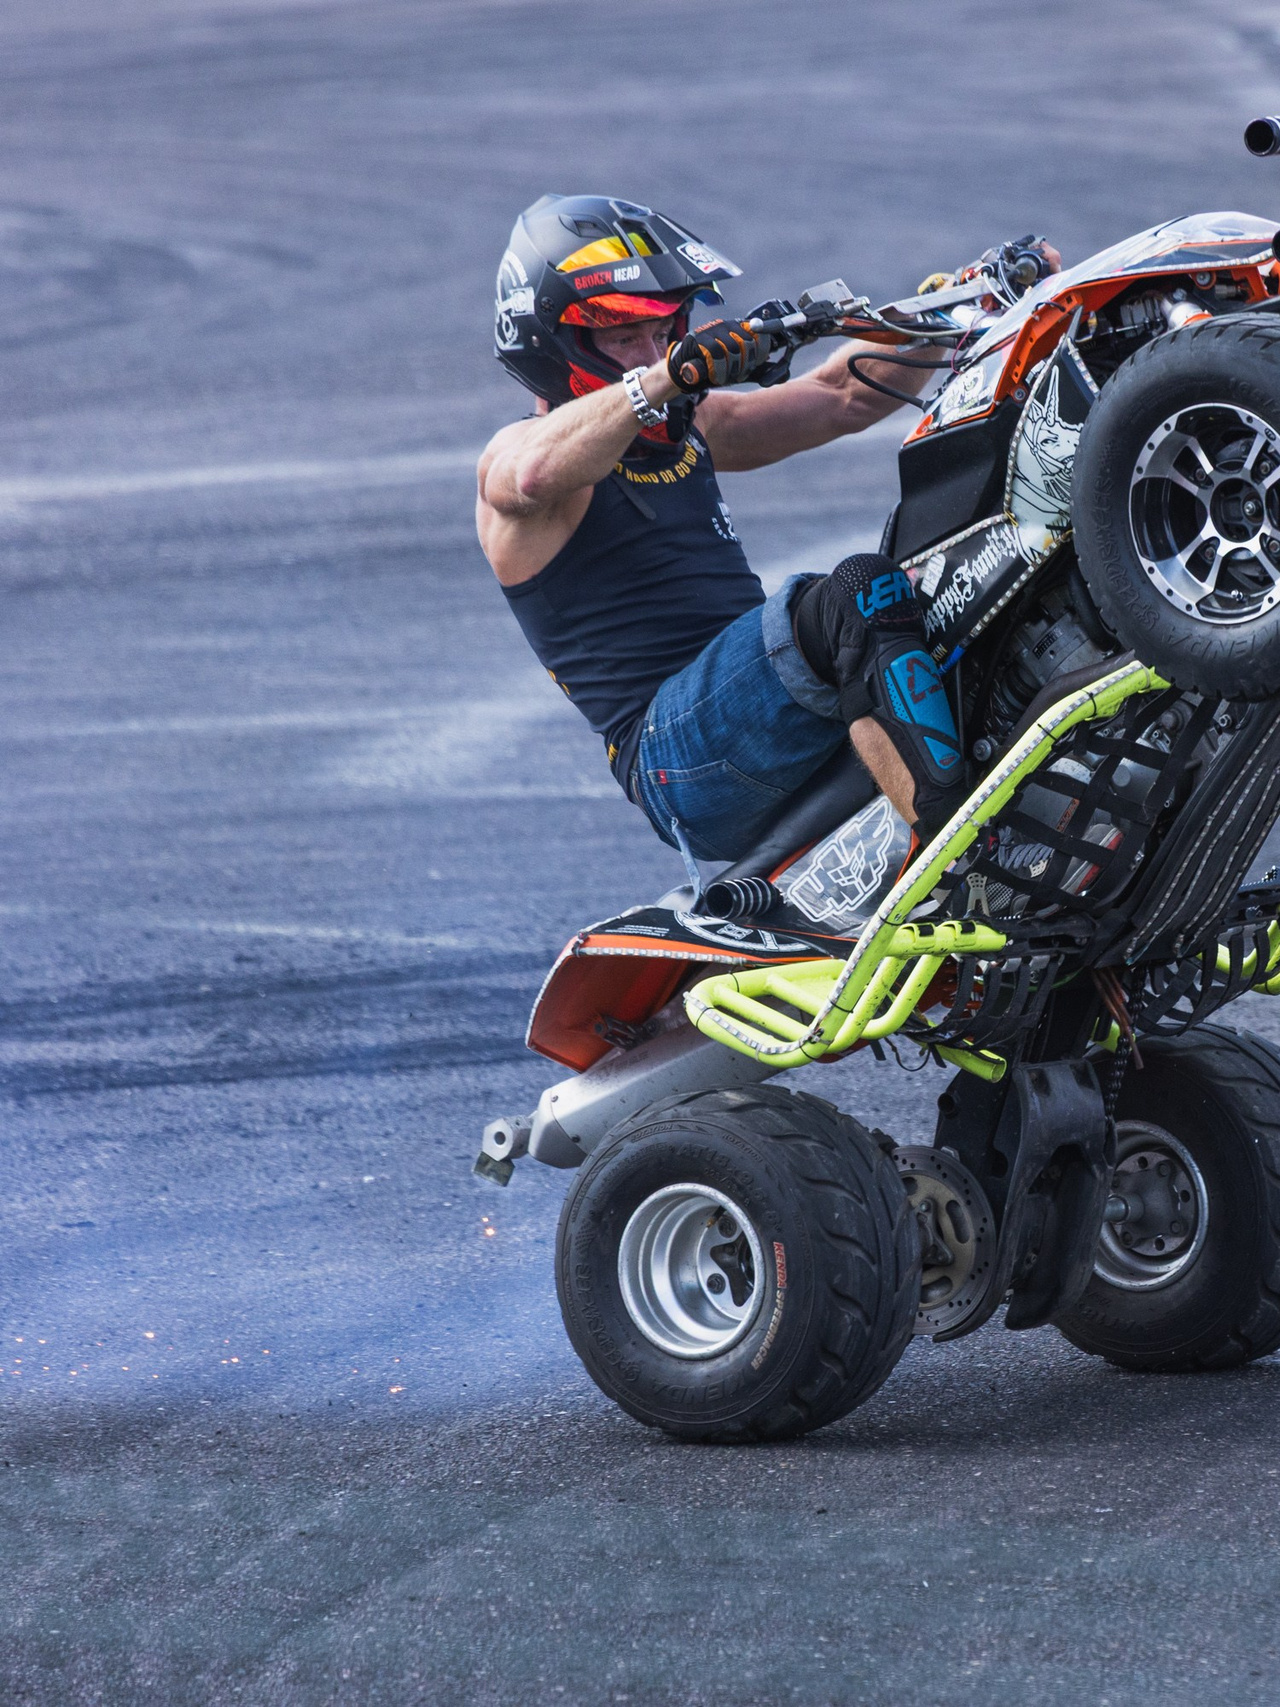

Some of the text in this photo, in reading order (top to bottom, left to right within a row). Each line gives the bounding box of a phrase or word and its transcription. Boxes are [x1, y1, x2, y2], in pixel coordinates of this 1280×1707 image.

[573, 264, 641, 291] BROKEN HEAD
[659, 469, 677, 484] OR
[674, 461, 691, 479] GO
[856, 571, 912, 618] LEA
[921, 554, 946, 597] HEAD
[751, 1241, 787, 1371] KENDA SPEEDRACER
